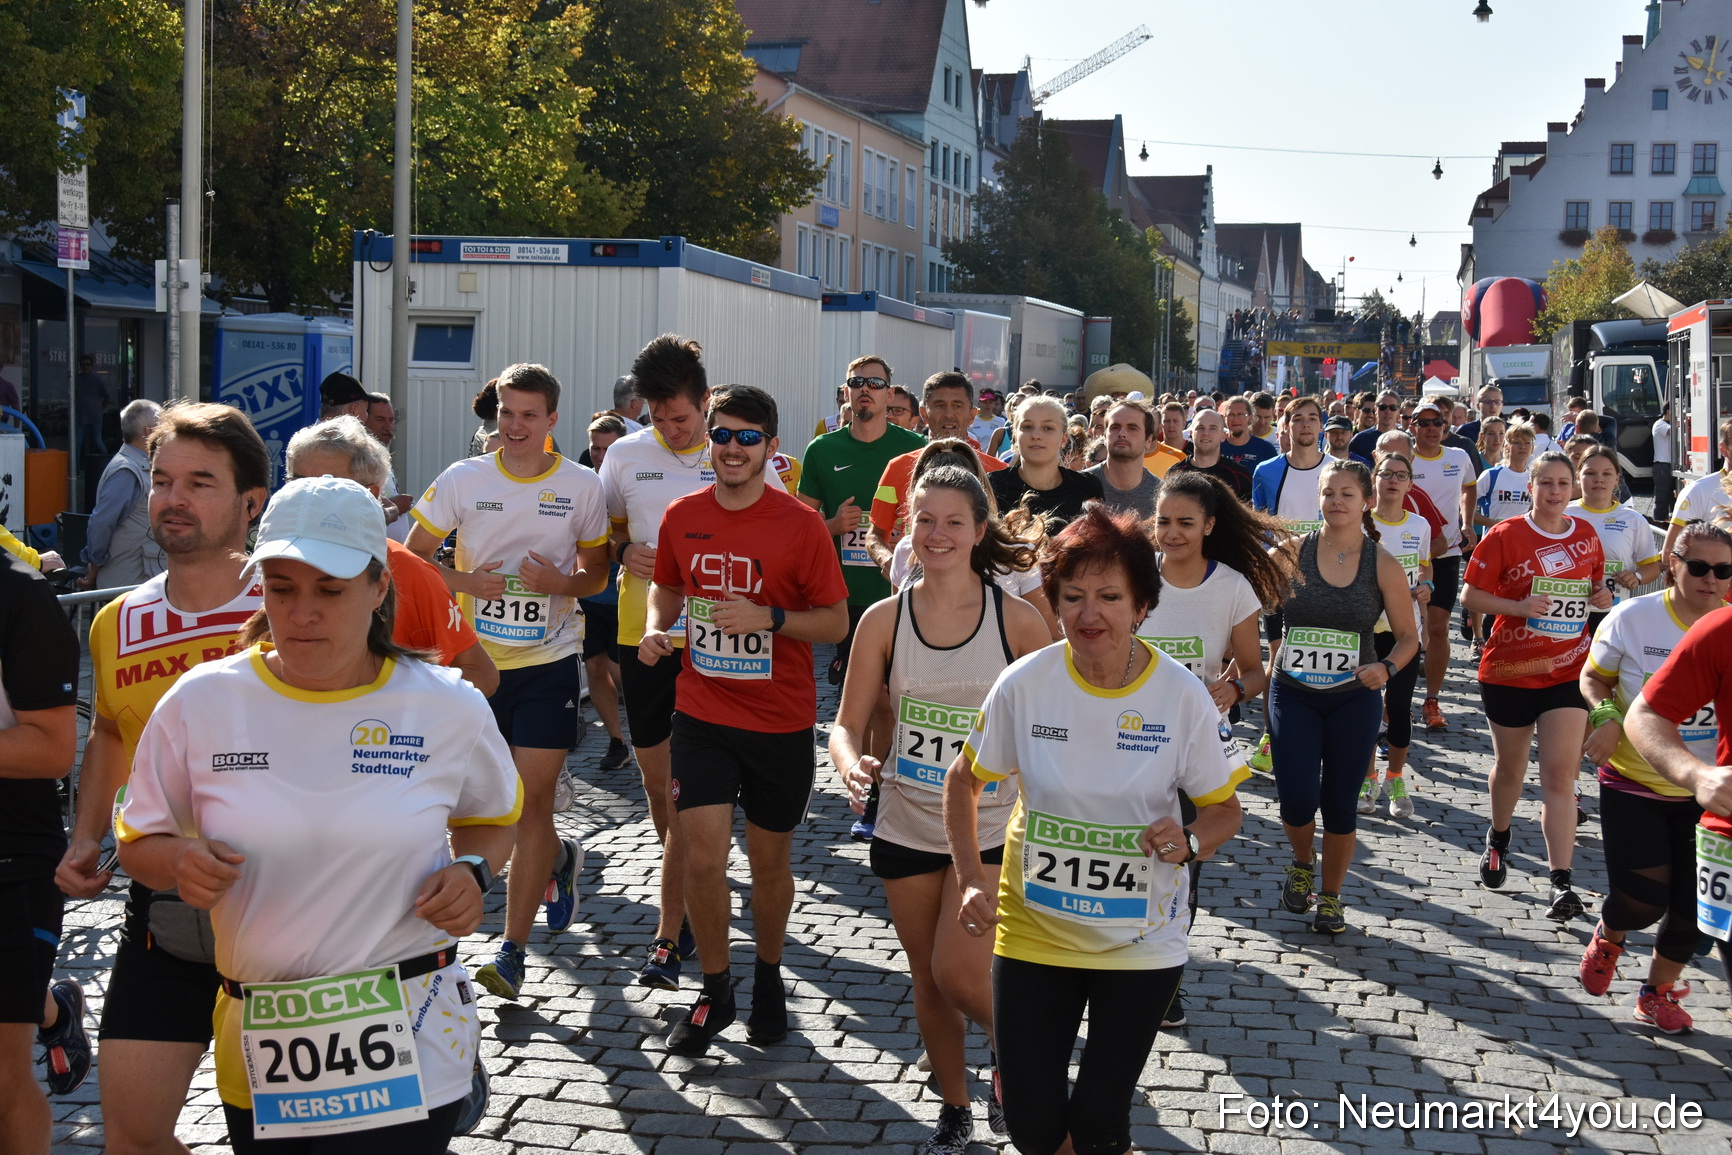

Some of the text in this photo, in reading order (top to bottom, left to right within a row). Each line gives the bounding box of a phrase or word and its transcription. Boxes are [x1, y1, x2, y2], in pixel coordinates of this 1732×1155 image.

[517, 246, 535, 254] 08141
[551, 247, 560, 255] 80
[242, 340, 264, 349] 08141
[271, 342, 285, 350] 536
[287, 342, 296, 351] 80
[1303, 345, 1342, 355] START
[49, 350, 67, 362] STRE
[781, 475, 794, 483] GL
[540, 492, 556, 502] 20
[538, 510, 567, 518] Stadtlauf
[539, 503, 574, 511] Neumarkter
[847, 531, 866, 547] 25
[1539, 582, 1588, 594] BOCK
[481, 599, 540, 622] 2318
[1541, 600, 1586, 618] 263
[480, 622, 538, 637] ALEXANDER
[695, 624, 762, 654] 2110
[1292, 631, 1353, 648] BOCK
[695, 653, 761, 670] SEBASTIAN
[1291, 649, 1349, 671] 2112
[116, 652, 191, 689] MAX
[1305, 674, 1334, 683] NINA
[1032, 724, 1069, 738] BOCK
[1120, 715, 1142, 731] 20
[354, 726, 422, 746] 20 JAHRE
[1118, 732, 1171, 743] Neumarkter
[907, 730, 966, 762] 211
[1116, 742, 1160, 754] Stadtlauf
[213, 752, 269, 767] BOCK
[353, 749, 431, 763] Neumarkter
[351, 763, 415, 779] Stadtlauf
[916, 768, 945, 782] CEL
[1036, 817, 1139, 852] BOCK
[1036, 851, 1136, 892] 2154
[1699, 866, 1731, 901] 66
[1061, 896, 1106, 915] LIBA
[251, 975, 390, 1023] BOCK
[258, 1023, 404, 1084] 2046 D
[278, 1087, 391, 1119] KERSTIN
